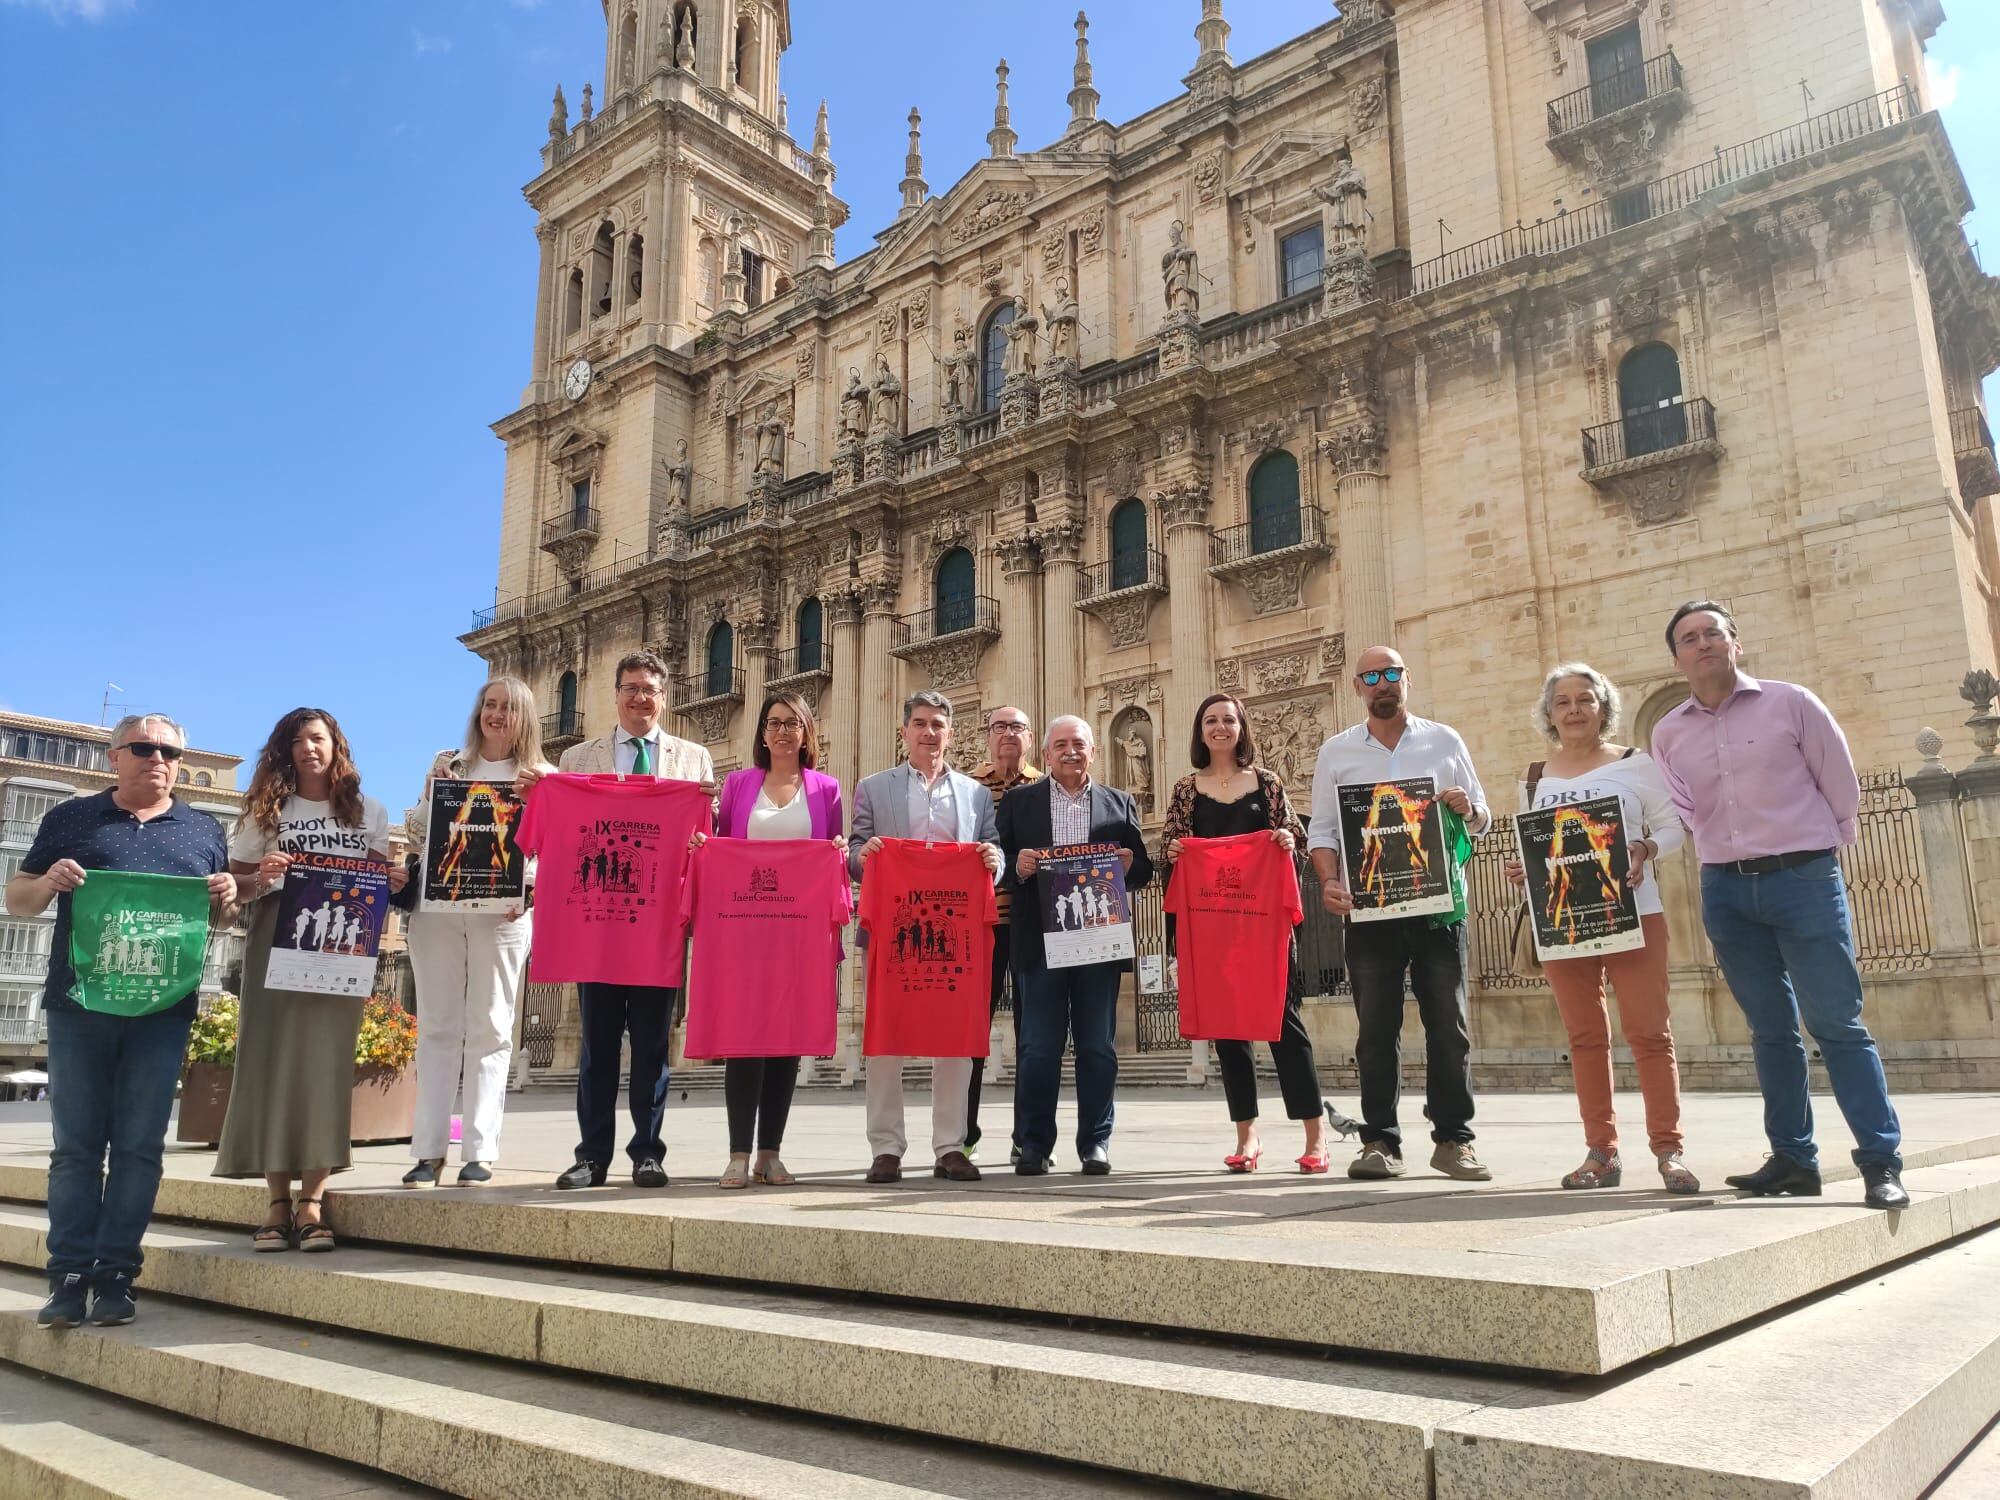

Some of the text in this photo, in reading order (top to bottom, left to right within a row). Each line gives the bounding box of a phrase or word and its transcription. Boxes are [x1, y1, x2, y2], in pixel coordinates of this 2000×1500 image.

[279, 817, 326, 833] ENJOY
[449, 821, 509, 833] Memorias
[595, 820, 661, 835] IX CARRERA
[1361, 821, 1421, 836] Memorias
[1561, 829, 1571, 837] DE
[278, 832, 366, 853] HAPPINESS
[1053, 843, 1116, 858] CARRERA
[1545, 848, 1611, 866] Memorias
[291, 863, 326, 873] NOCTURNA
[313, 855, 388, 874] CARRERA
[908, 889, 968, 905] IX CARRERA
[119, 909, 183, 925] IX CARRERA
